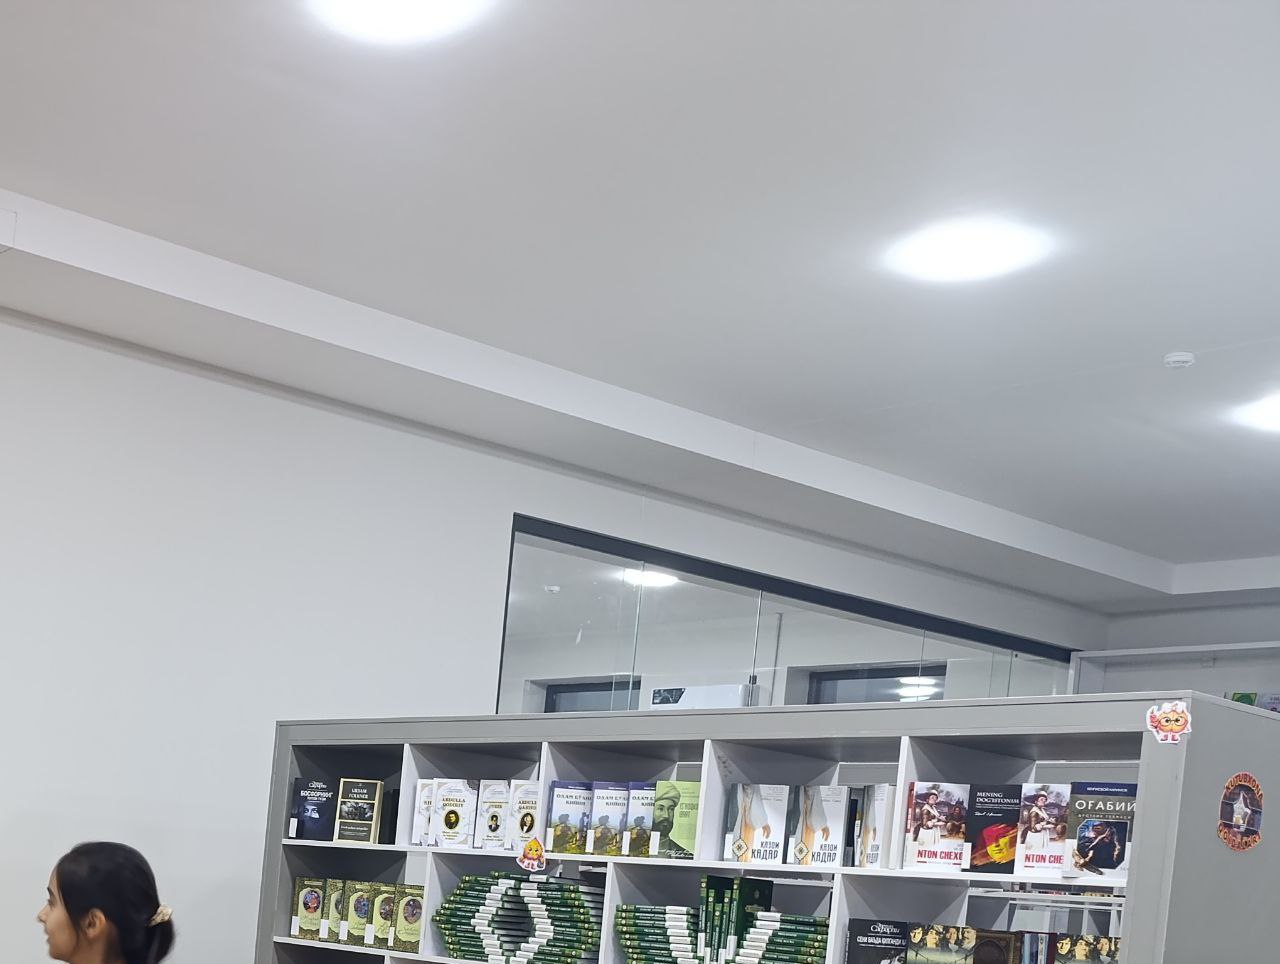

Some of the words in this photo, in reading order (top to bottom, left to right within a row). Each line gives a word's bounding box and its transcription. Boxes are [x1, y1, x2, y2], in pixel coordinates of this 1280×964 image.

[917, 849, 938, 859] NTON
[939, 851, 963, 861] CHEXO
[1024, 853, 1046, 863] NTON
[1048, 855, 1064, 865] CHE
